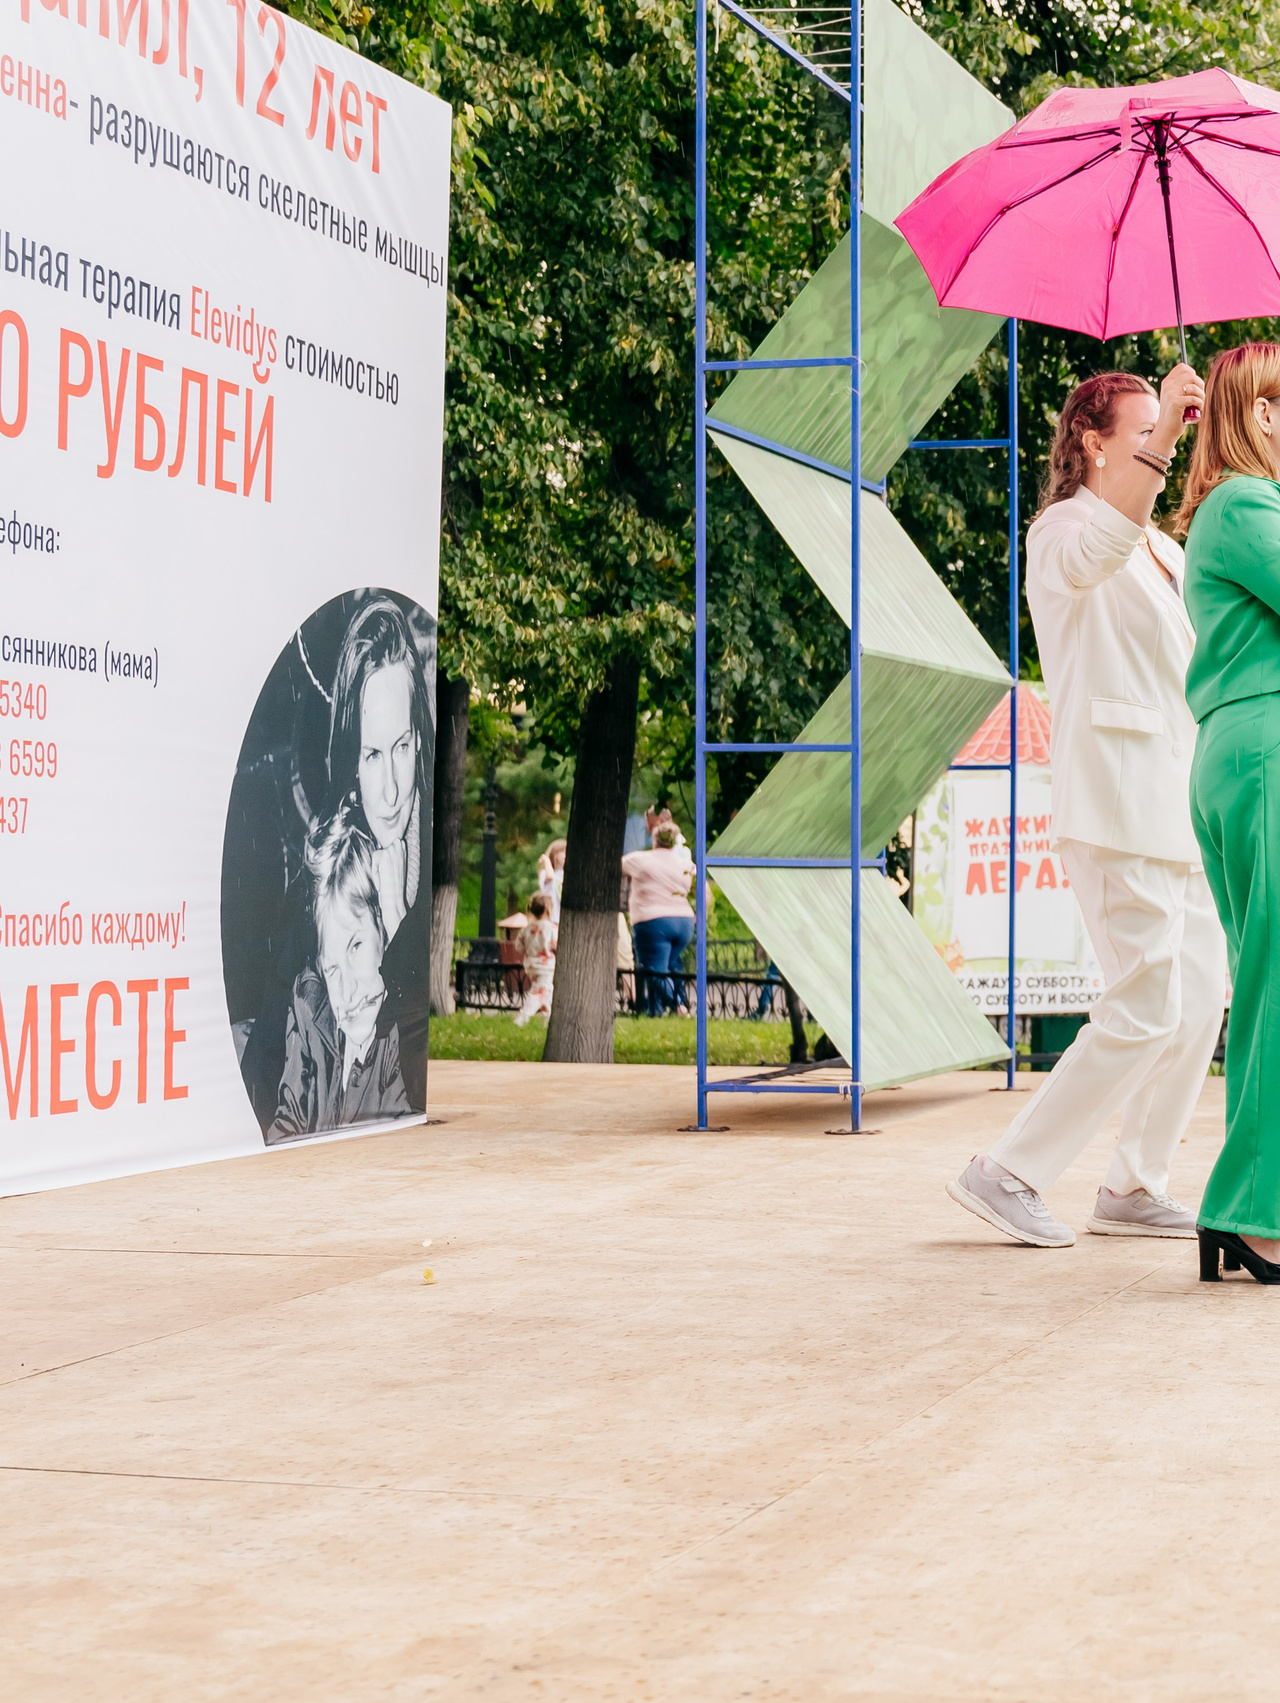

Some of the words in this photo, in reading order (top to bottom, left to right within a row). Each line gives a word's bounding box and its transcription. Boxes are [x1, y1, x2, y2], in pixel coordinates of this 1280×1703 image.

[227, 0, 287, 127] 12
[306, 64, 388, 174] лет
[90, 93, 250, 201] разрушаются
[258, 173, 368, 253] скелетные
[375, 225, 444, 288] мышцы
[0, 229, 69, 292] ьная
[79, 258, 181, 330] терапия
[190, 285, 277, 367] Elevidys
[284, 334, 399, 406] стоимостью
[58, 327, 275, 503] РУБЛЕЙ
[2, 635, 97, 673] сянникова
[104, 640, 159, 688] (мама)
[9, 739, 58, 778] 6599
[965, 814, 1052, 838] ЖАРКИ
[969, 838, 1050, 857] ПРАЗНИ
[91, 901, 186, 950] каждому!
[1048, 993, 1056, 1004] И
